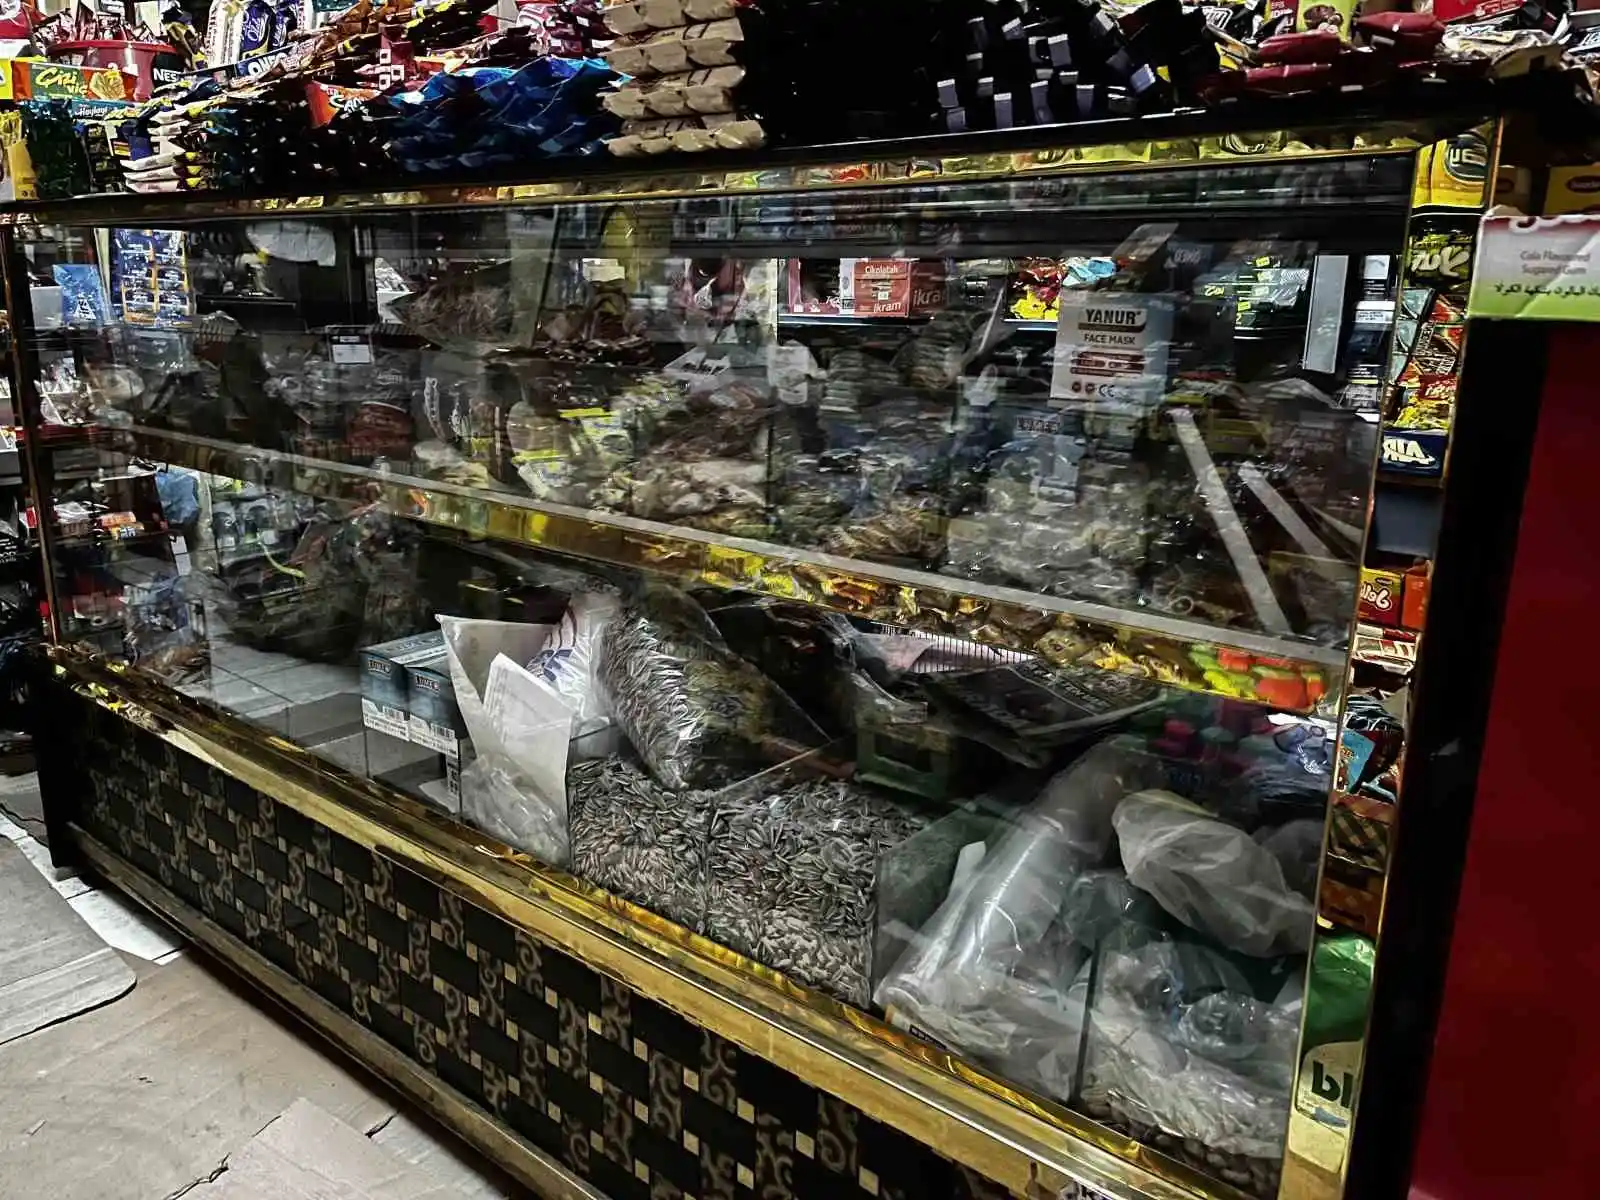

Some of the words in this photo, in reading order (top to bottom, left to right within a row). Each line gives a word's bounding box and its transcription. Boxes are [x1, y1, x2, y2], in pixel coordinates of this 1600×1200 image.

[911, 287, 948, 308] ikra
[1086, 308, 1137, 325] YANUR
[1084, 333, 1107, 344] FACE
[1109, 335, 1136, 345] MASK
